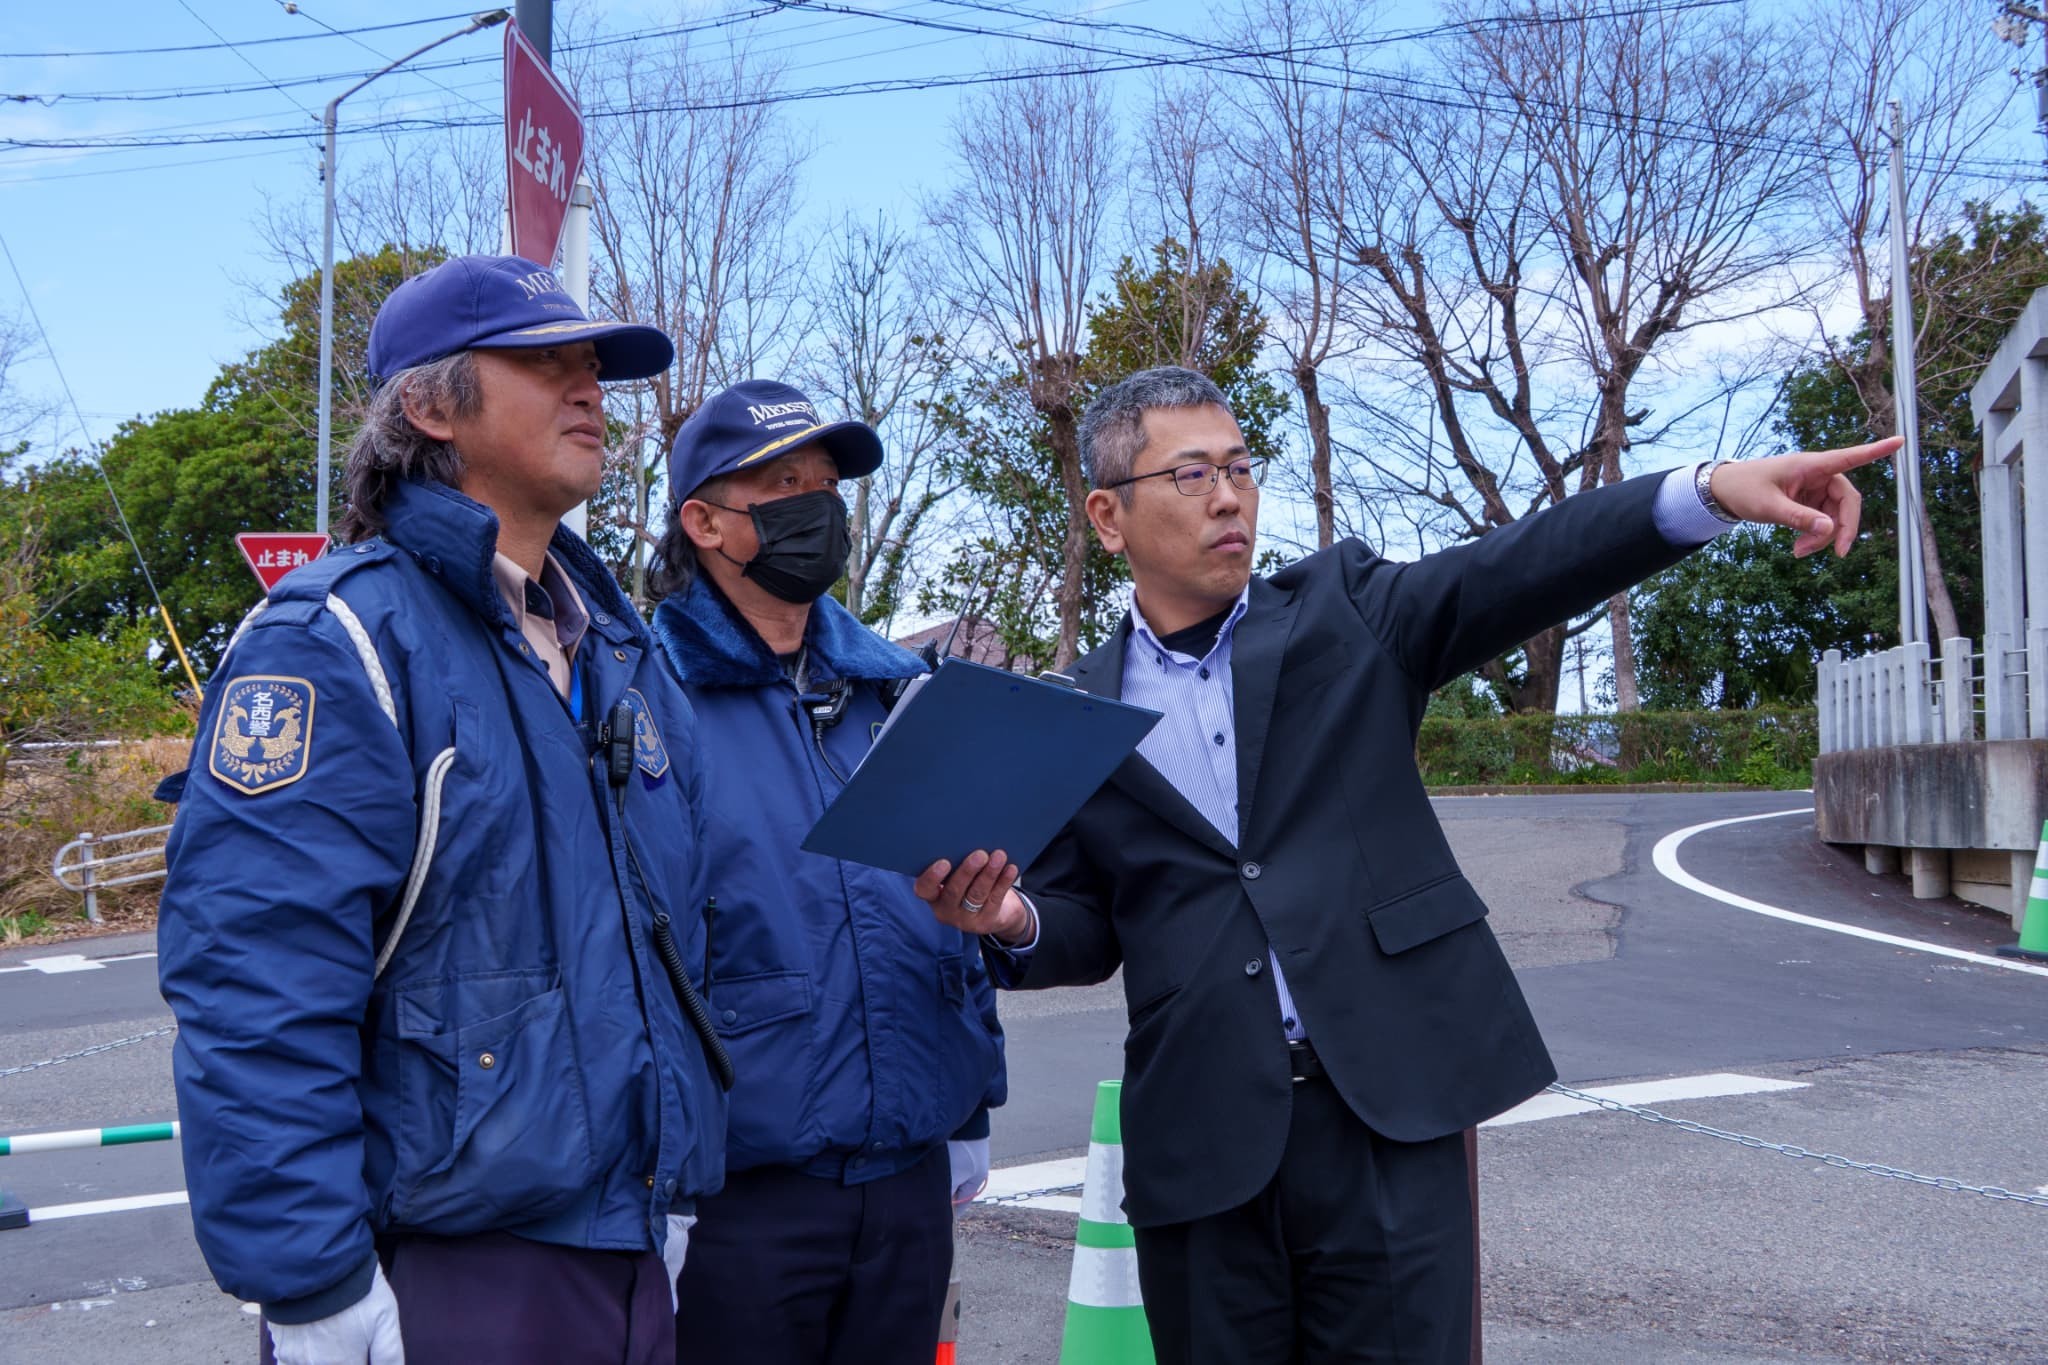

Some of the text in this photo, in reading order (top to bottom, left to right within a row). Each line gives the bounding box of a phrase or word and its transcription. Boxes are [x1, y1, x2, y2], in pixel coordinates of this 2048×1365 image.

[514, 107, 566, 202] 止まれ
[257, 549, 312, 567] 止まれ
